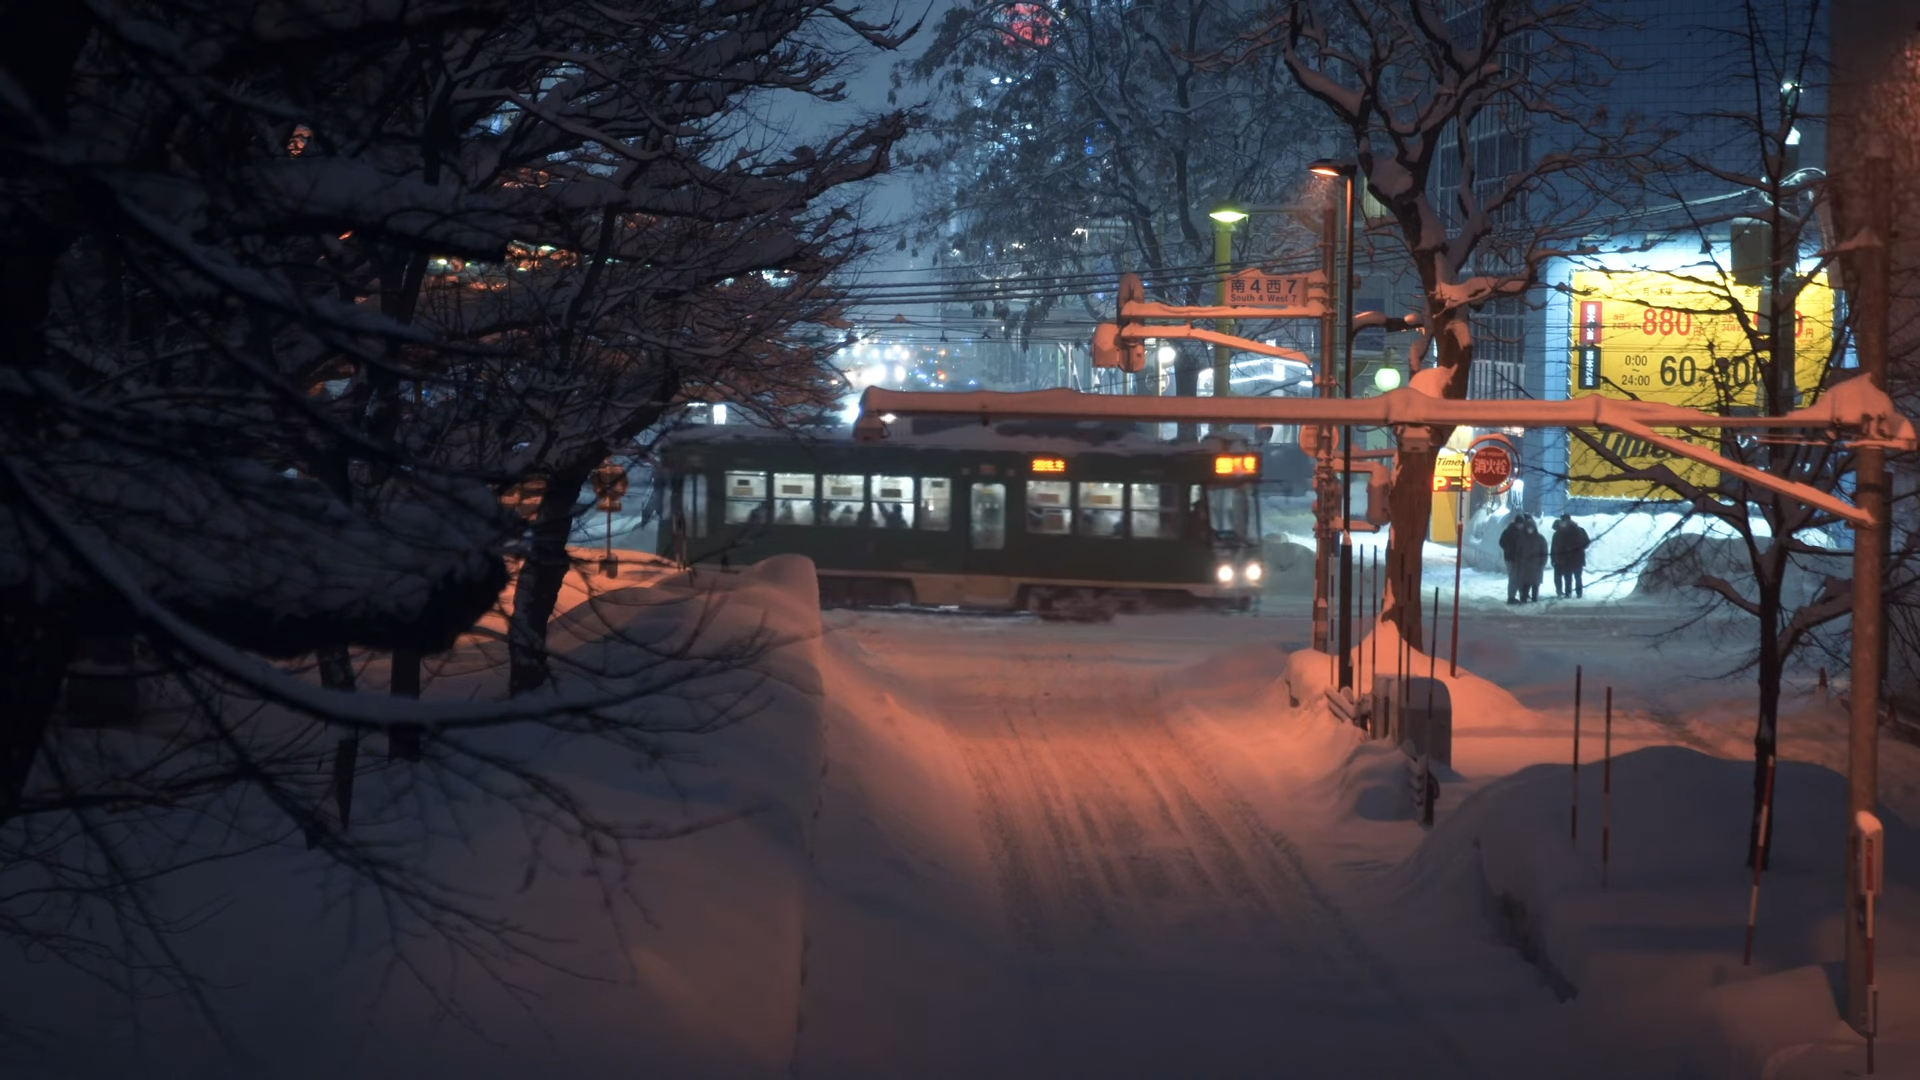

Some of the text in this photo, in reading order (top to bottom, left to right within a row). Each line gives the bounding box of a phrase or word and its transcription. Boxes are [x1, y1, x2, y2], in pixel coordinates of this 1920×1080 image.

[1231, 294, 1255, 302] South
[1267, 295, 1288, 303] West
[1291, 295, 1298, 303] 7
[1643, 308, 1691, 336] 880
[1805, 328, 1814, 338] 円
[1625, 355, 1648, 366] 0:00
[1660, 356, 1696, 387] 60
[1621, 375, 1650, 386] 24:00
[1474, 458, 1508, 475] 消火栓
